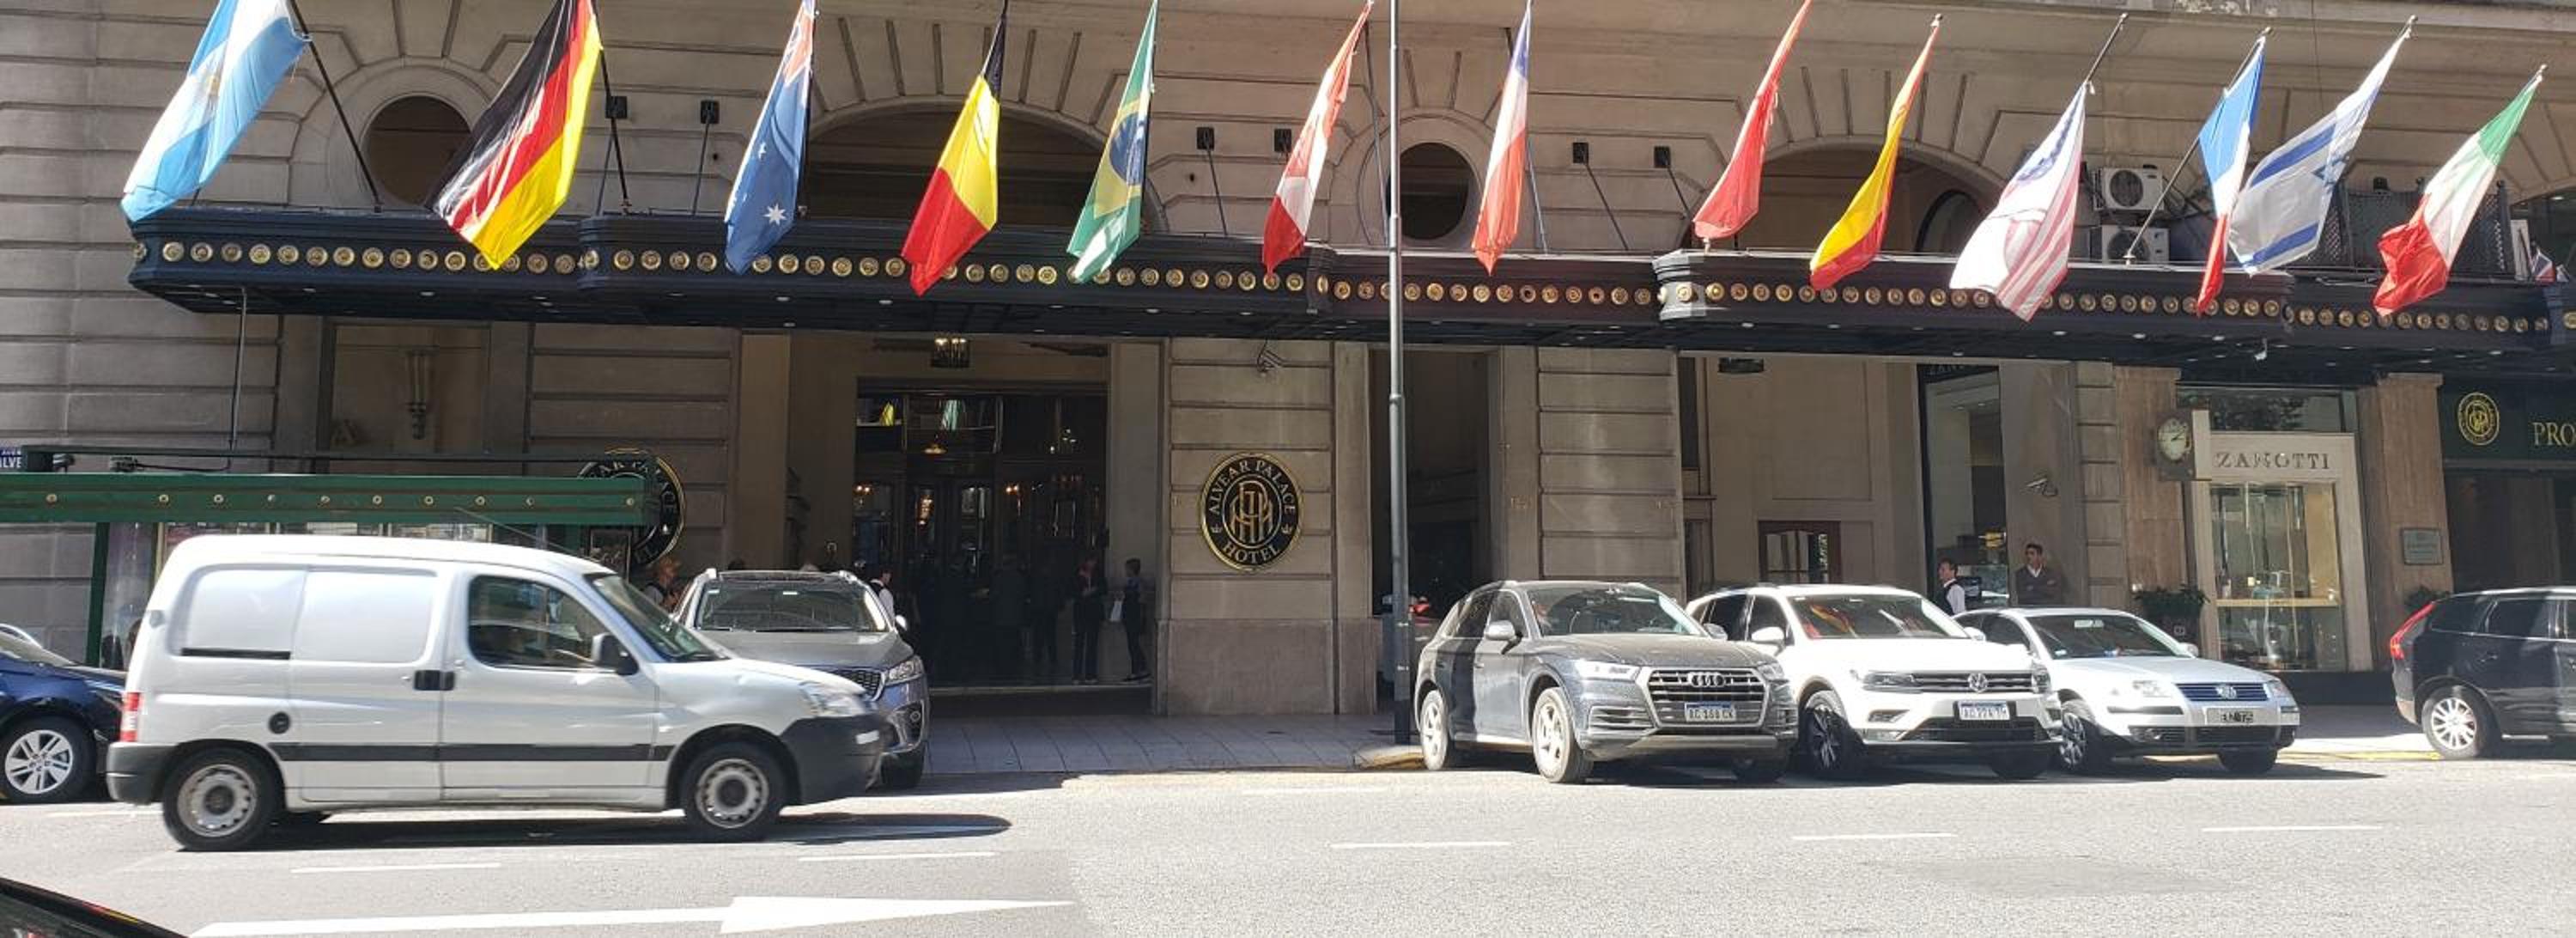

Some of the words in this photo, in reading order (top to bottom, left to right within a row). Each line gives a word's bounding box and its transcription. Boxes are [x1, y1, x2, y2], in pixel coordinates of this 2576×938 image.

[2530, 422, 2576, 447] PRO
[2216, 452, 2330, 470] ZANOTTI
[1209, 460, 1251, 515] ALVEAR
[1255, 460, 1297, 515] PALACE
[1223, 542, 1279, 564] HOTEL
